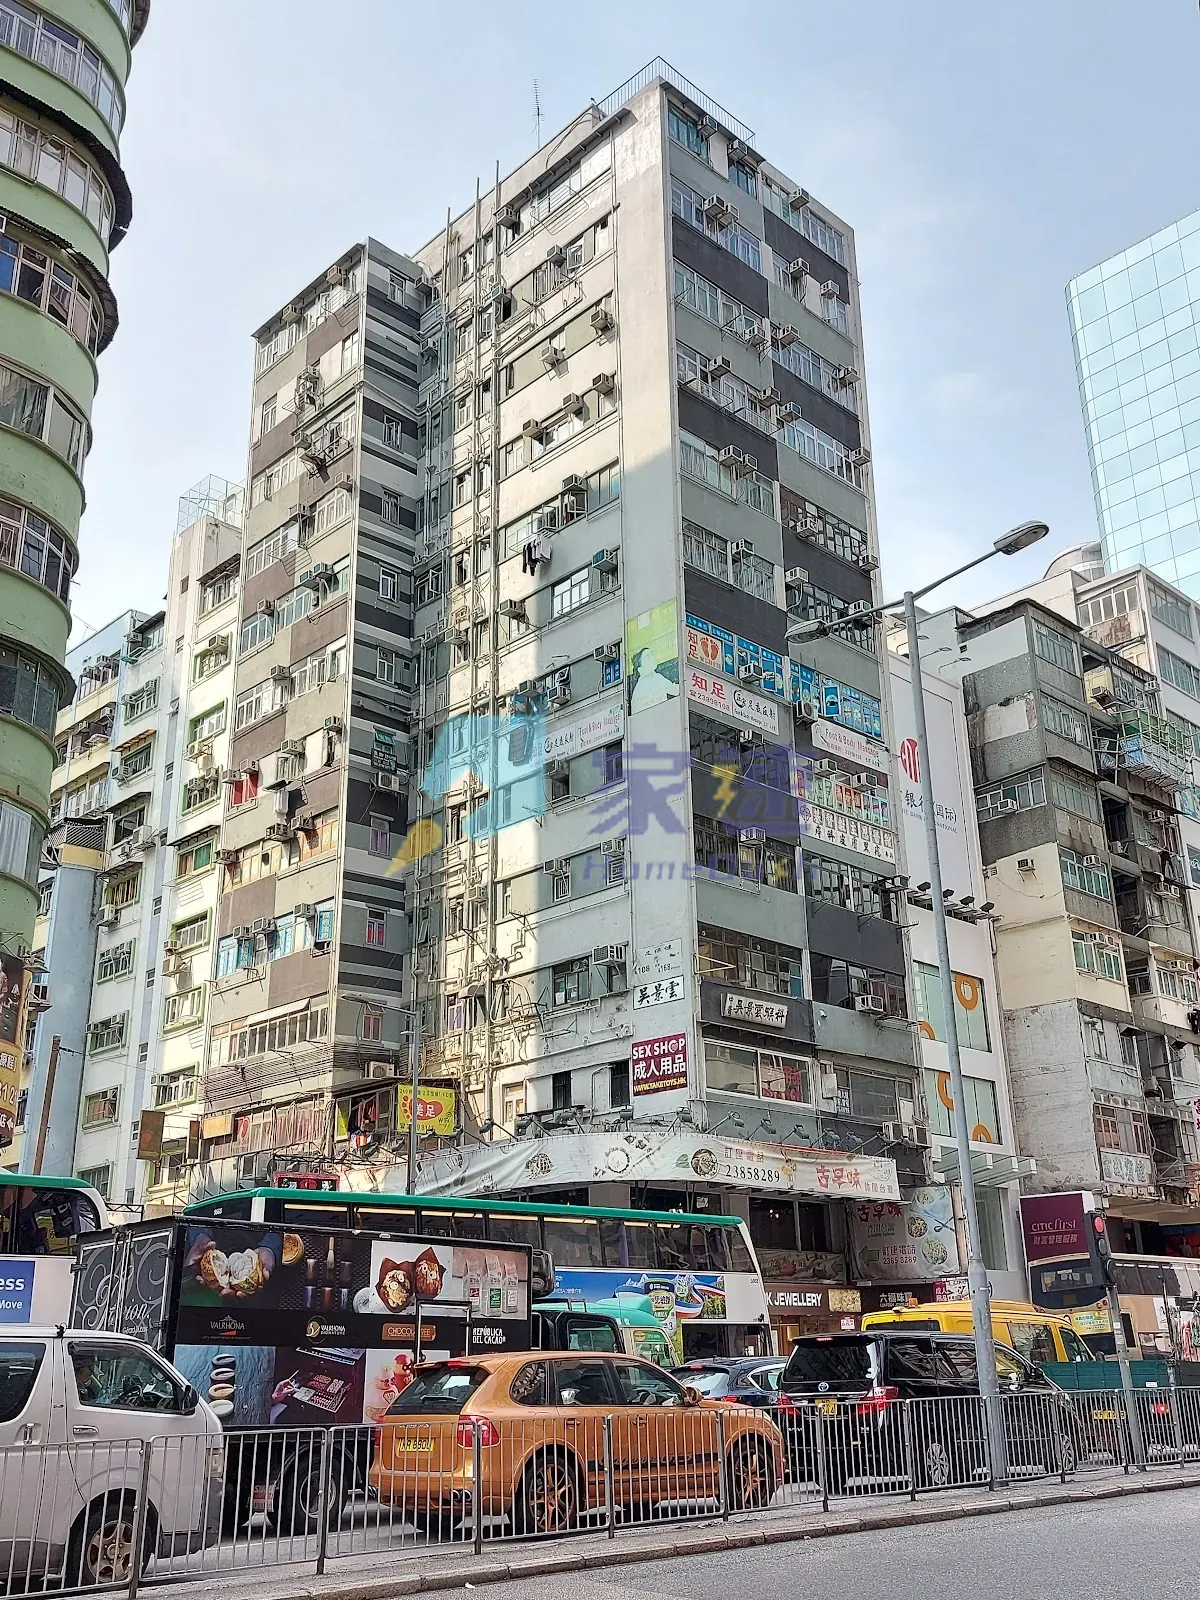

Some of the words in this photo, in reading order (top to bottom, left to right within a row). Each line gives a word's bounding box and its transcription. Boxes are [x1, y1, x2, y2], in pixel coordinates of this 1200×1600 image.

[691, 672, 726, 700] 知足
[632, 1044, 653, 1060] SEX
[654, 1037, 686, 1055] SHOP
[633, 1054, 686, 1081] 成人用品
[725, 1165, 780, 1183] 23858289
[816, 1164, 862, 1189] 古早味
[774, 1293, 822, 1307] JEWELLERY
[880, 1292, 913, 1303] 六福珠寶
[210, 1321, 245, 1330] VALRHONA
[472, 1326, 503, 1337] REPÚBLICA
[472, 1336, 483, 1344] DEL
